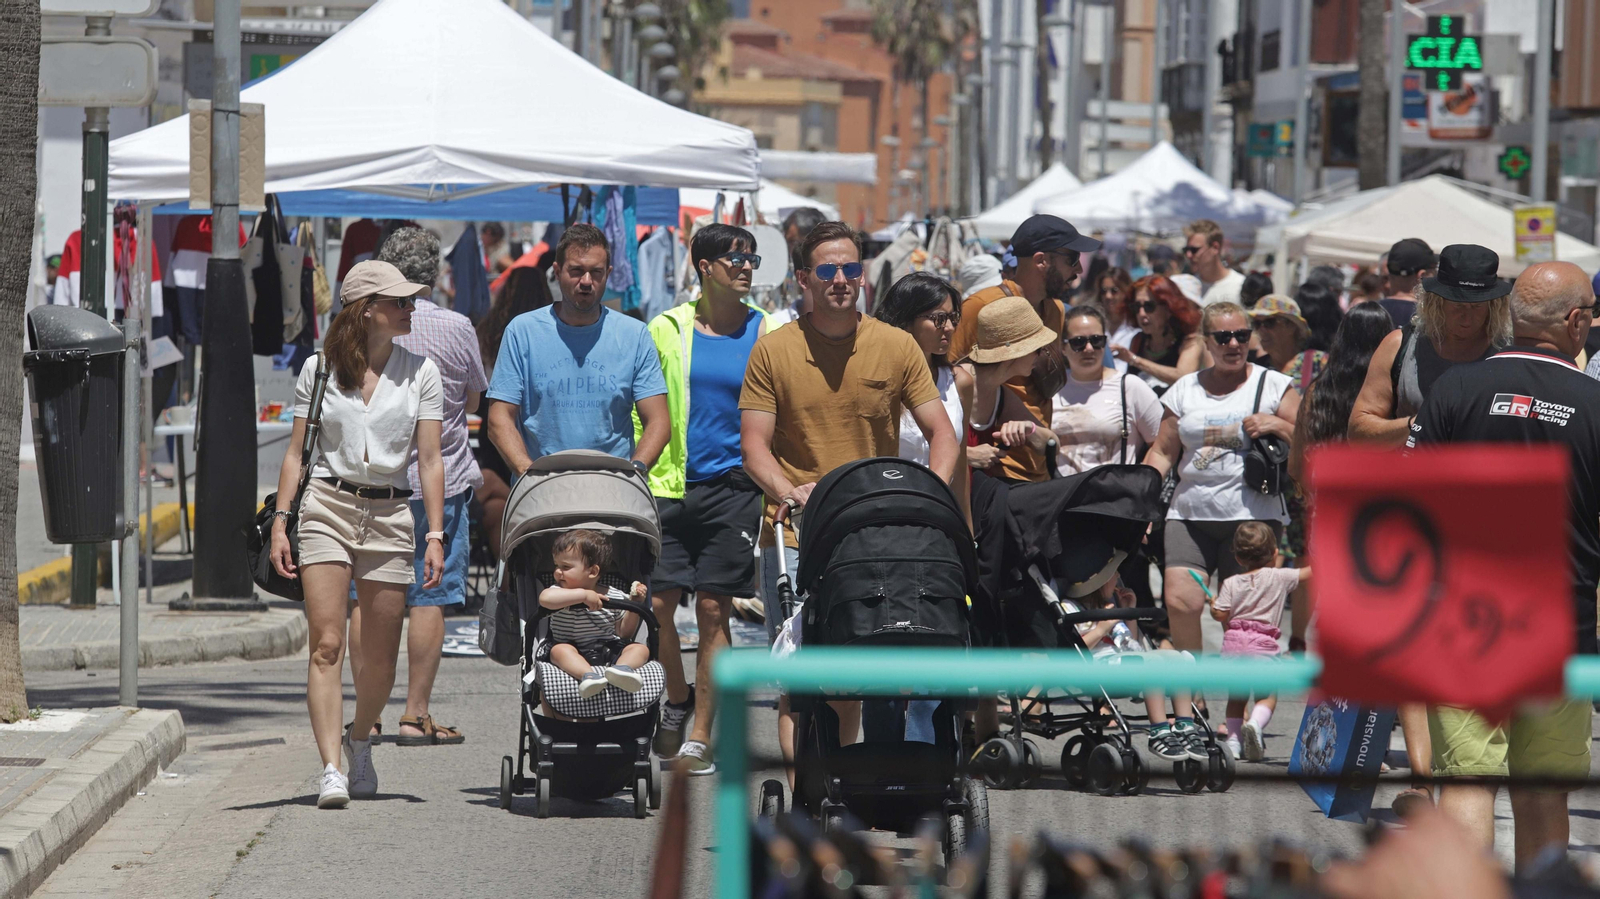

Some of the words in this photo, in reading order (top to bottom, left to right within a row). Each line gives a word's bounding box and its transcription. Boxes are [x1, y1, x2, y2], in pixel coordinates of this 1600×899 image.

[1409, 36, 1482, 68] CIA
[550, 356, 606, 373] HERIAGE
[535, 374, 618, 399] SCALPERS
[553, 399, 575, 408] ARUBA
[576, 400, 600, 409] ISLAND
[1492, 401, 1529, 416] GR
[1534, 399, 1576, 414] TOYOTA
[1530, 412, 1568, 427] Racing
[1532, 405, 1571, 419] GAZOO
[1356, 709, 1378, 767] movistar
